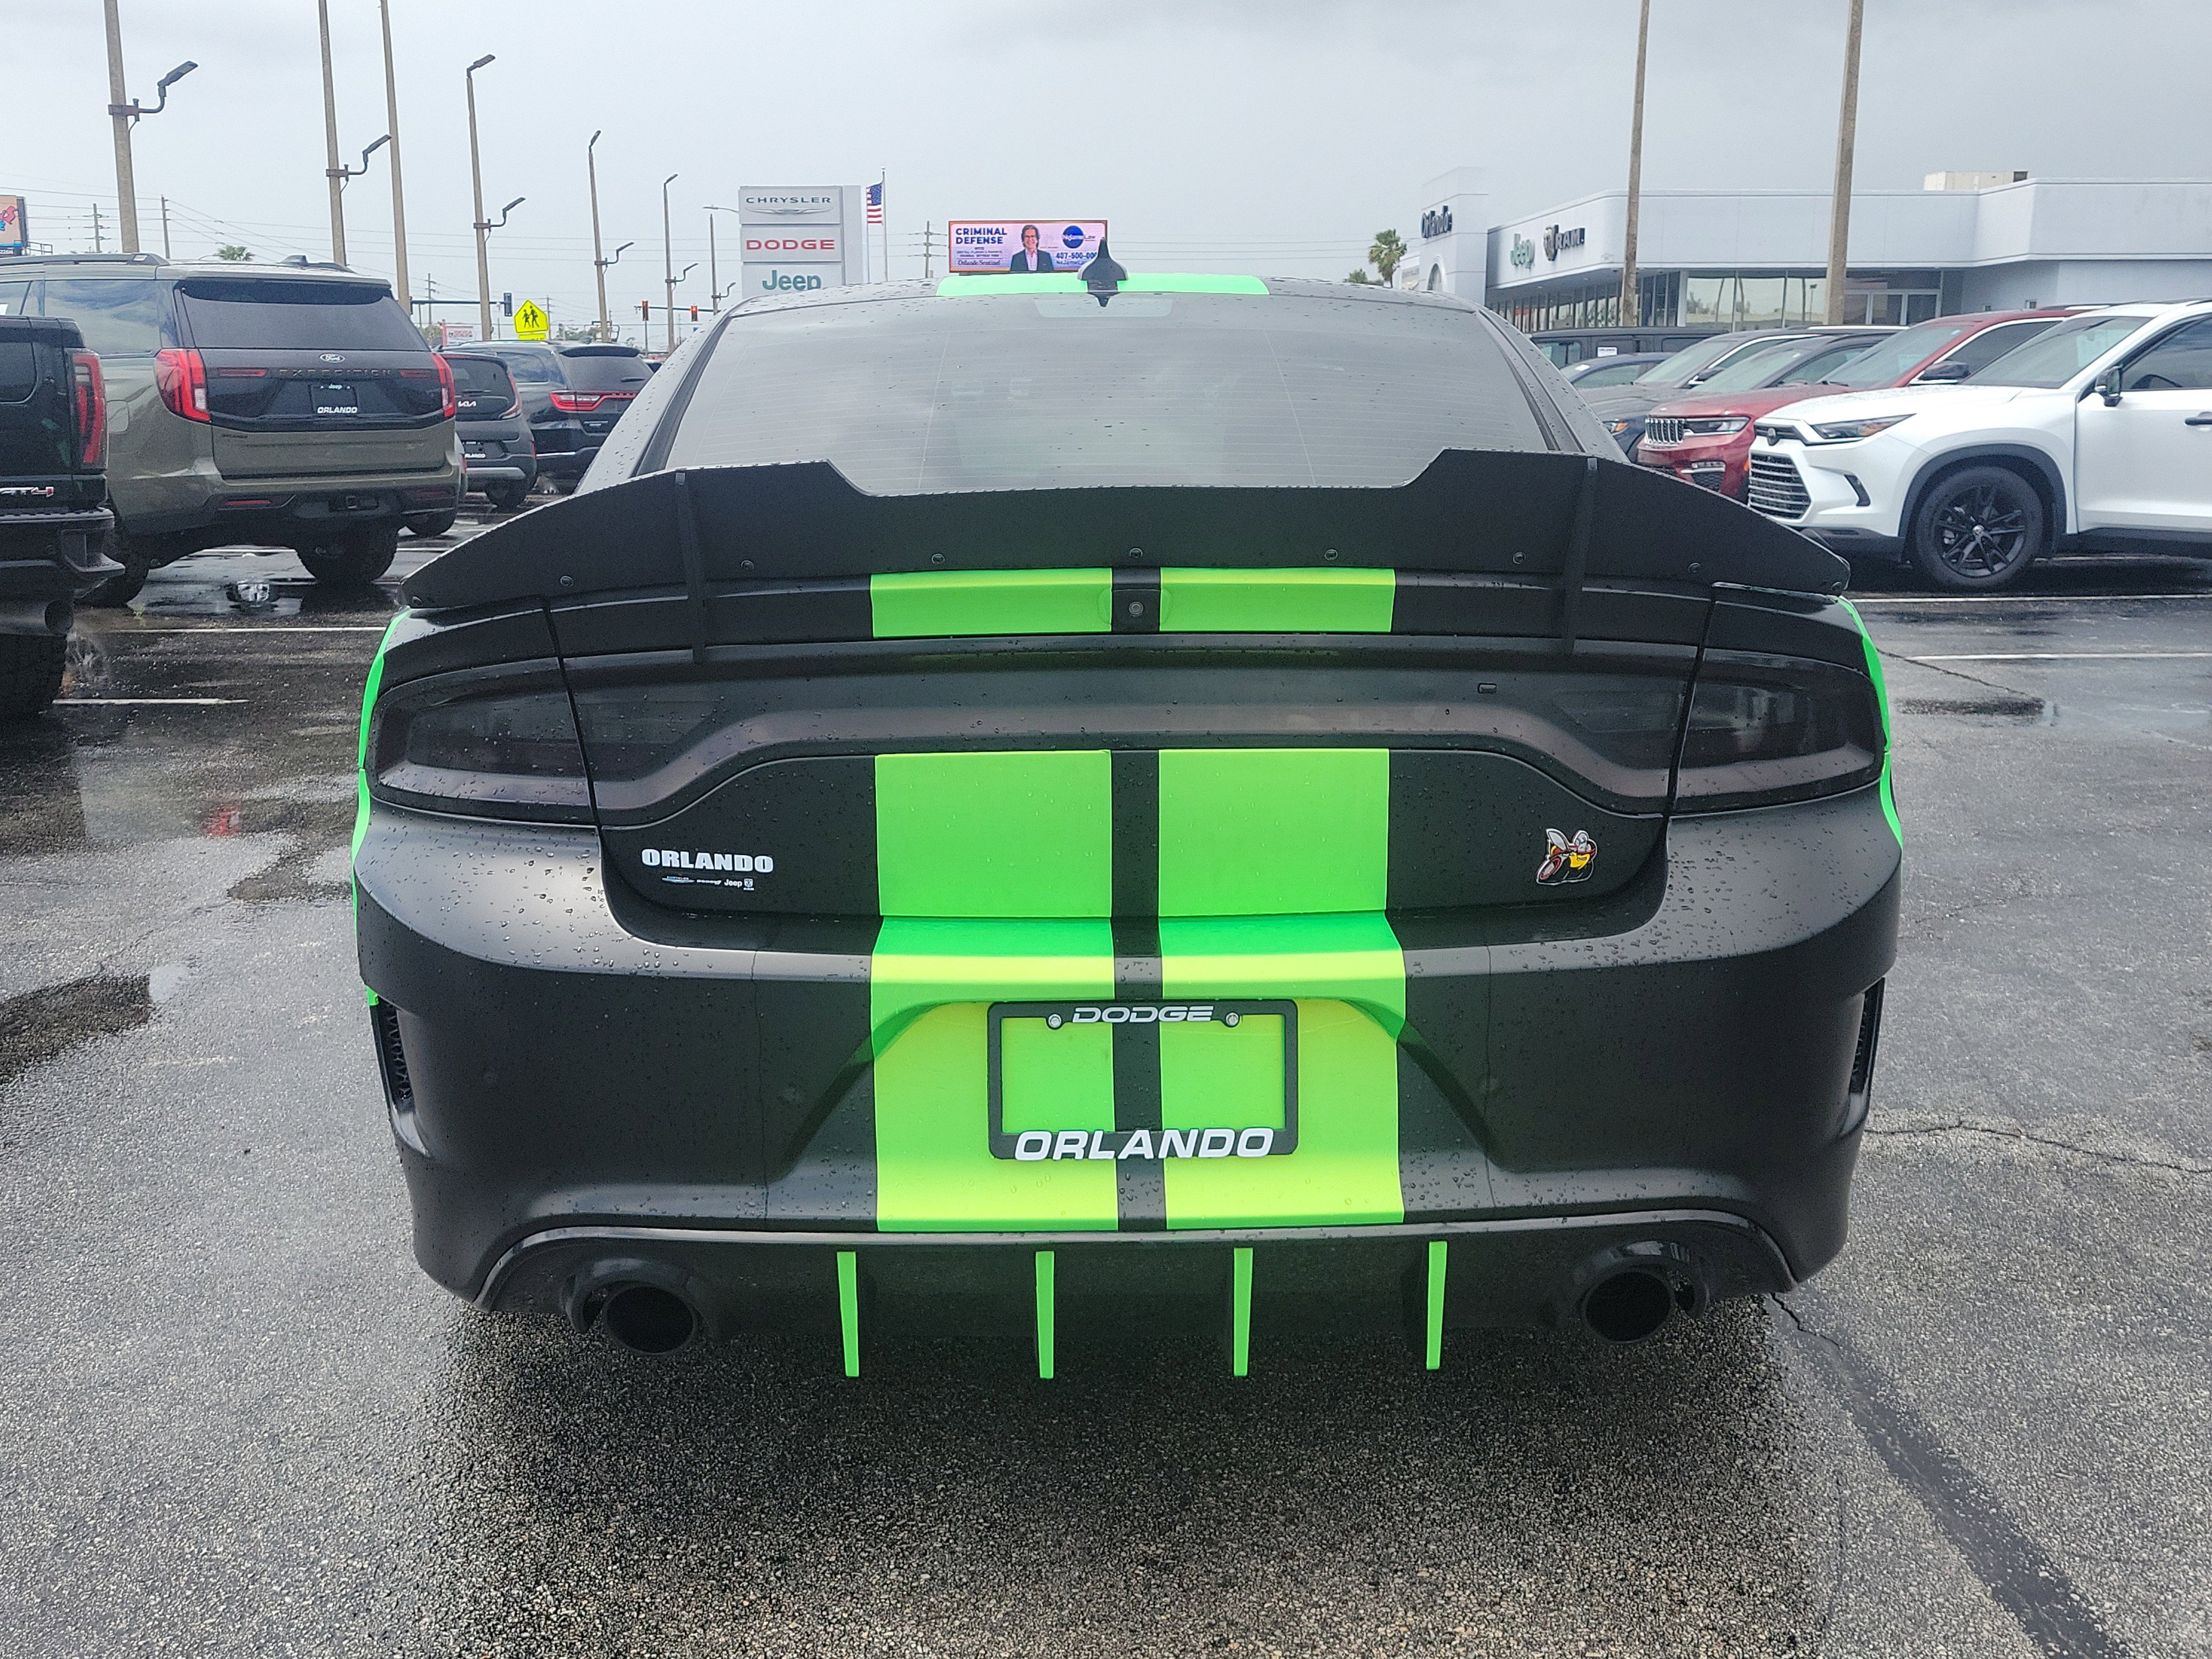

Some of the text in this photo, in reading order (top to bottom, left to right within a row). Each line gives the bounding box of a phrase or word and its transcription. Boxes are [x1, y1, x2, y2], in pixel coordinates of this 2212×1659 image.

[956, 227, 1008, 235] CRIMINAL
[956, 236, 1003, 245] DEFENSE
[1555, 228, 1585, 249] RAM
[747, 240, 834, 250] DODGE
[1510, 233, 1535, 269] Jeep
[279, 369, 391, 377] EXPEDITION
[317, 406, 358, 414] ORLANDO
[641, 849, 774, 873] ORLANDO
[724, 878, 742, 888] Jeep
[1072, 1005, 1214, 1024] DODGE
[1014, 1127, 1274, 1161] ORLANDO
